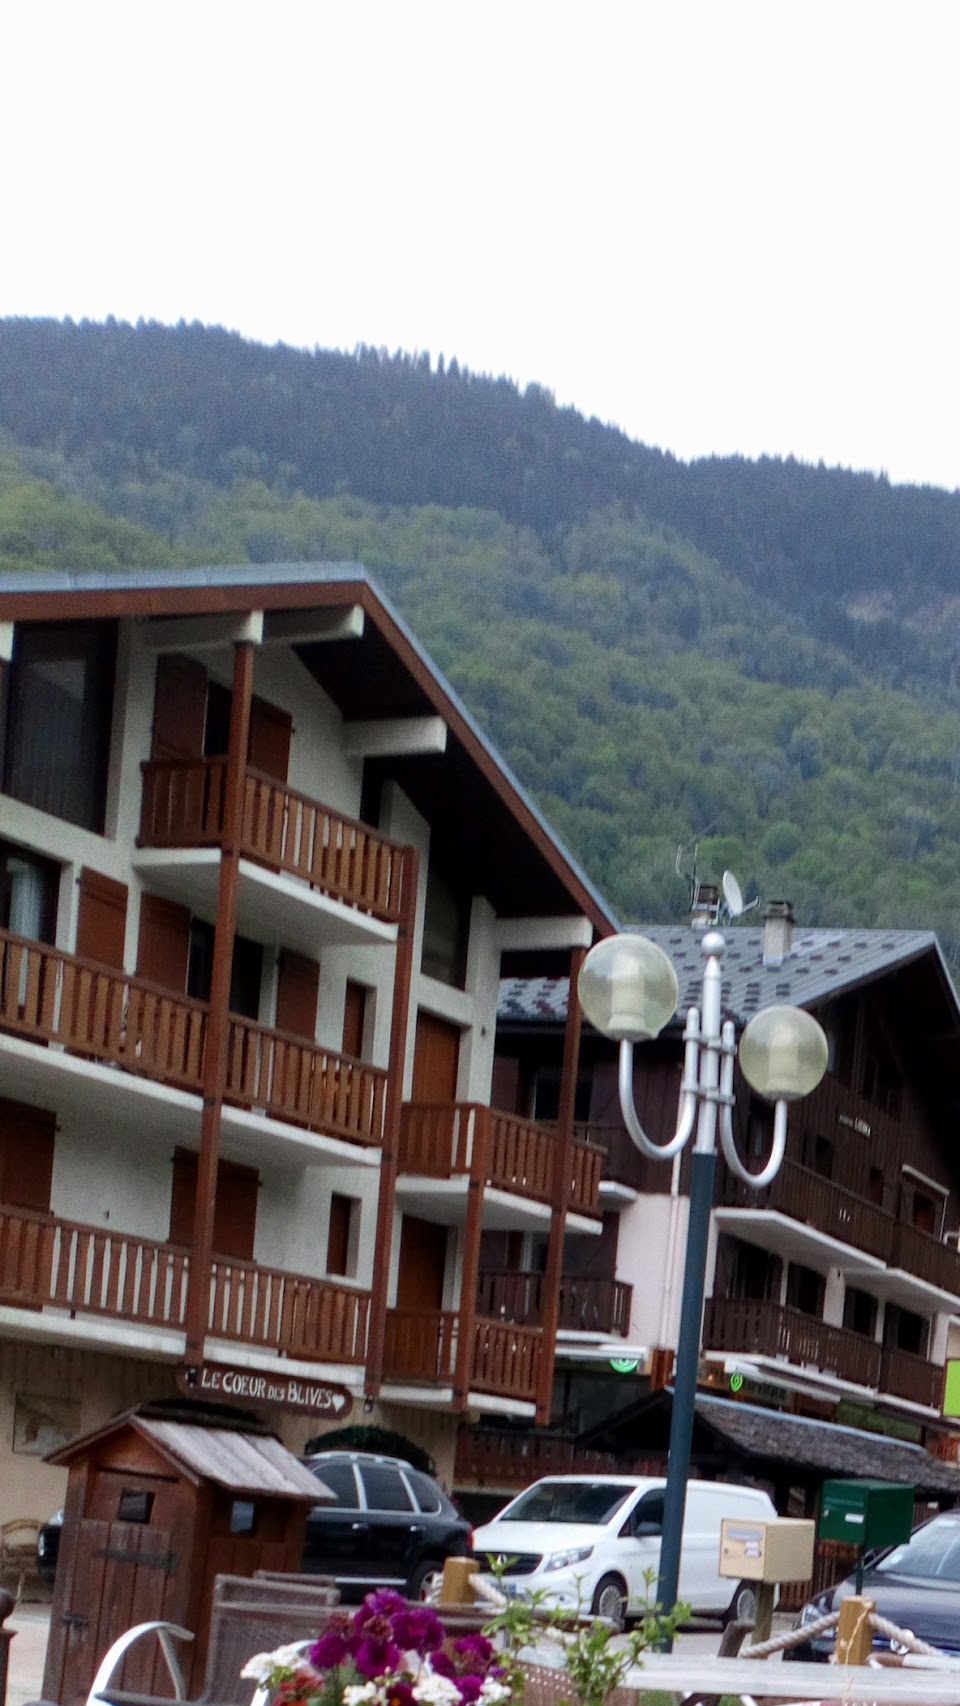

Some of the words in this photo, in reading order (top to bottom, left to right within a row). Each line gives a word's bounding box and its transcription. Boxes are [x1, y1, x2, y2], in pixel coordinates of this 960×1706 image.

[201, 1367, 221, 1391] LE
[222, 1371, 266, 1398] COEUR
[287, 1382, 332, 1409] BLIVES
